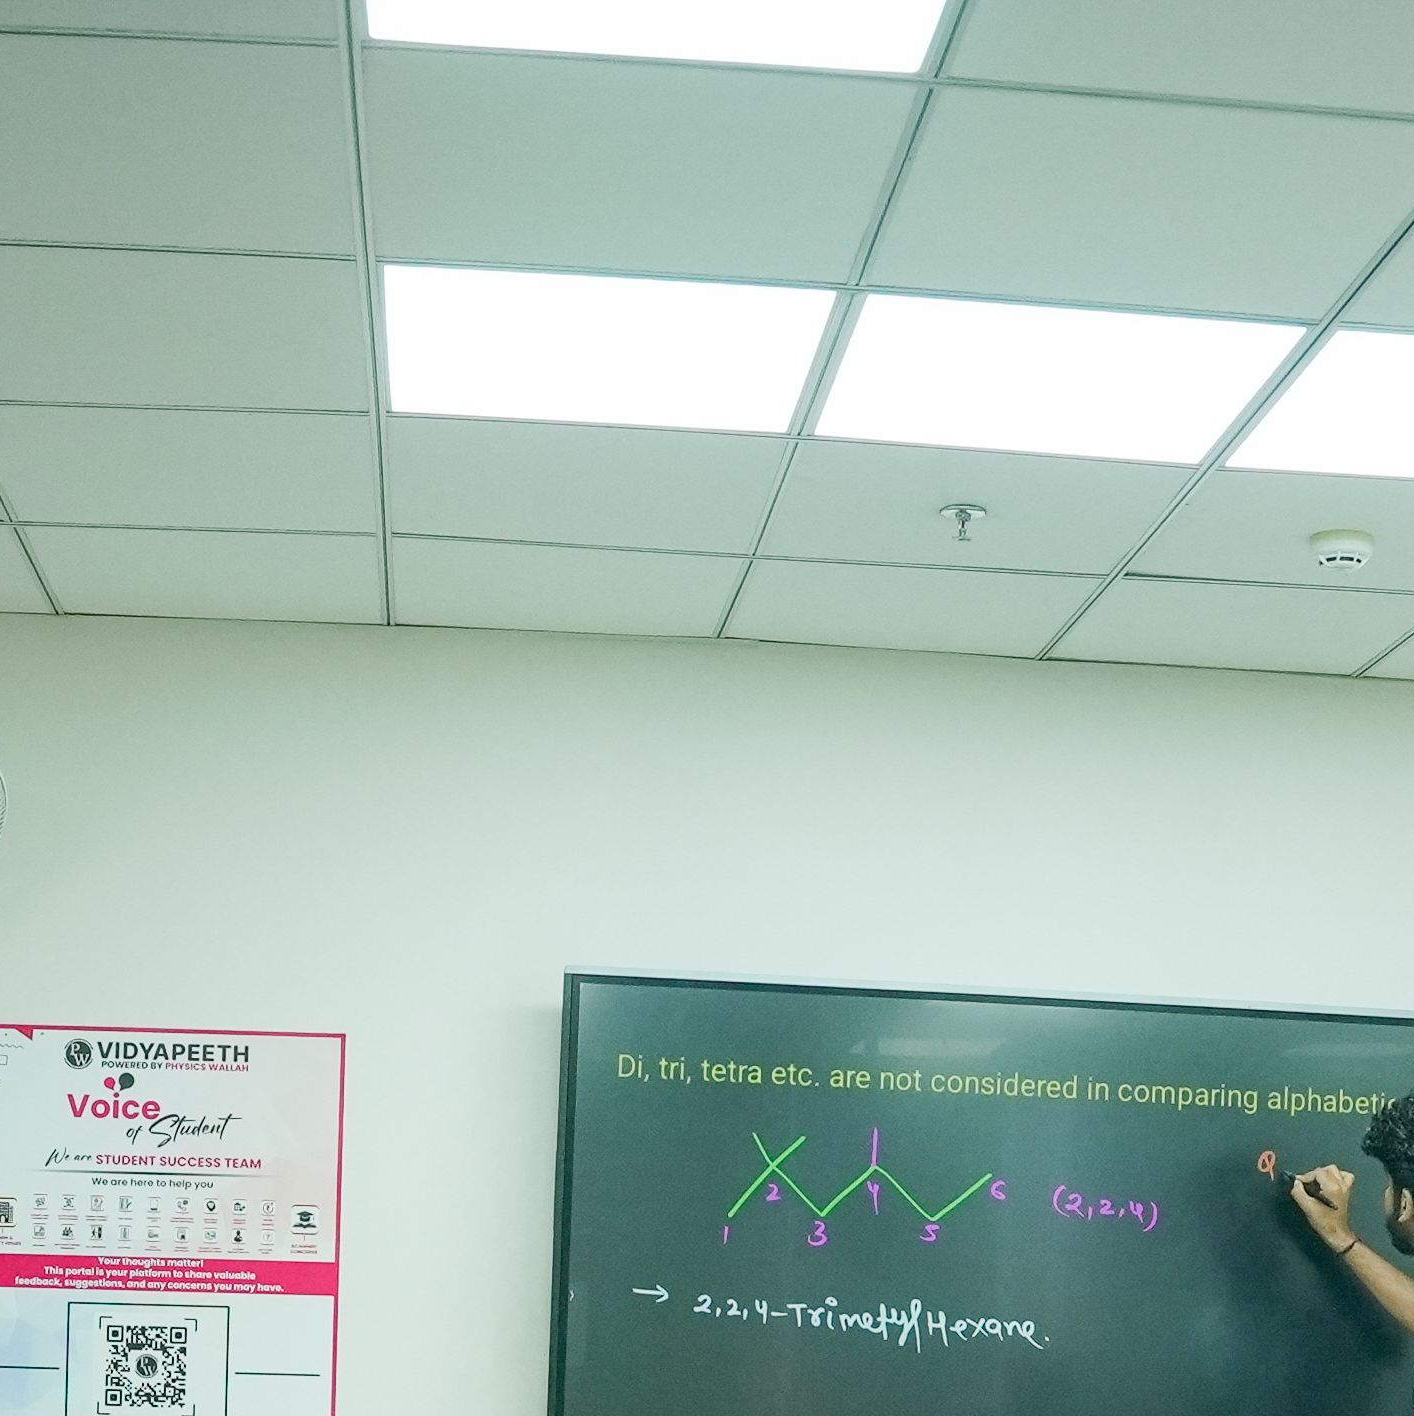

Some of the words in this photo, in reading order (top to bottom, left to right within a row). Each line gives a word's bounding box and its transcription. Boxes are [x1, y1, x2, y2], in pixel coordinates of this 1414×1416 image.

[97, 1041, 249, 1063] VIDYAPEETH
[101, 1060, 149, 1070] POWERED
[150, 1061, 164, 1070] BY
[165, 1062, 206, 1071] PHYSICS
[209, 1063, 249, 1072] WALLAH
[618, 1053, 650, 1083] Di,
[659, 1056, 691, 1085] tri,
[701, 1059, 762, 1084] tetra
[771, 1063, 820, 1087] etc.
[829, 1069, 871, 1089] are
[879, 1069, 922, 1092] not
[930, 1071, 1078, 1100] considered
[1087, 1076, 1110, 1101] in
[1118, 1083, 1258, 1115] comparing
[67, 1091, 161, 1120] Voice
[126, 1125, 143, 1145] of
[148, 1113, 243, 1148] Student
[44, 1147, 70, 1167] We
[73, 1153, 92, 1162] are
[95, 1154, 157, 1166] STUDENT
[159, 1155, 221, 1168] SUCCESS
[224, 1157, 262, 1169] TEAM
[91, 1176, 109, 1186] We
[110, 1178, 128, 1187] are
[130, 1177, 154, 1188] here
[156, 1179, 167, 1188] to
[169, 1179, 192, 1190] help
[194, 1181, 214, 1191] you
[765, 1182, 781, 1201] 2
[990, 1179, 1006, 1200] 6
[807, 1220, 828, 1246] 3
[44, 1265, 64, 1275] This
[65, 1267, 94, 1277] portal
[95, 1267, 104, 1276] is
[106, 1269, 128, 1278] your
[129, 1268, 171, 1279] platform
[173, 1270, 184, 1278] to
[184, 1270, 213, 1279] share
[213, 1271, 256, 1280] valuable
[97, 1256, 121, 1265] Your
[122, 1257, 166, 1268] thoughts
[15, 1275, 63, 1287] feedback,
[64, 1278, 125, 1289] suggestions,
[127, 1279, 146, 1288] and
[147, 1280, 167, 1291] any
[167, 1281, 213, 1290] concerns
[213, 1283, 234, 1293] you
[234, 1283, 256, 1294] may
